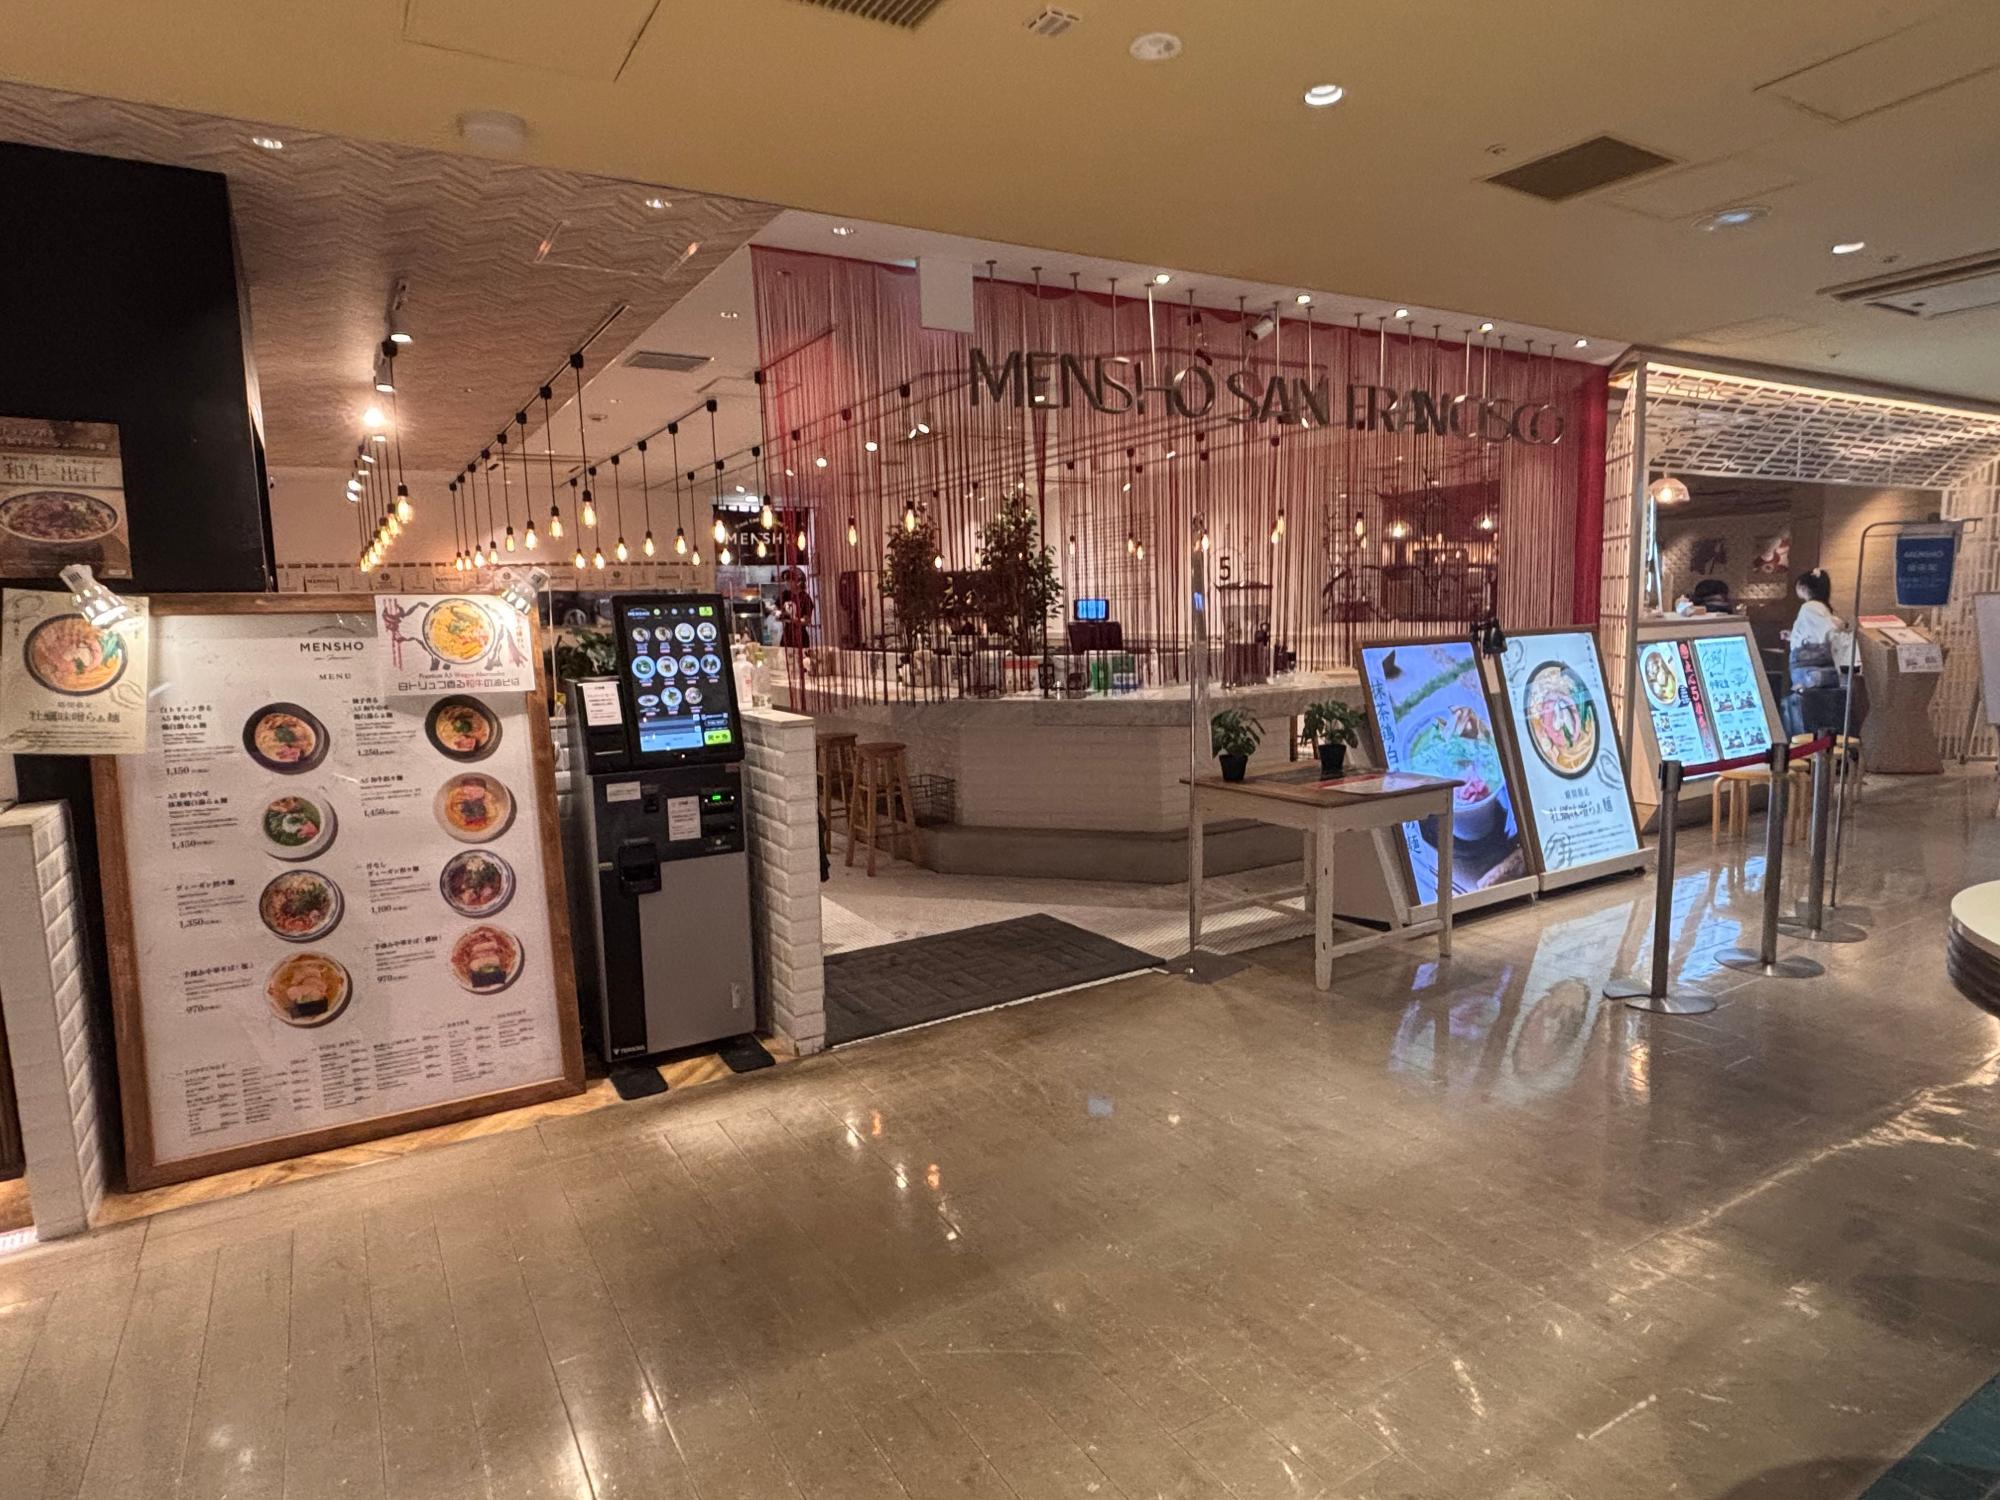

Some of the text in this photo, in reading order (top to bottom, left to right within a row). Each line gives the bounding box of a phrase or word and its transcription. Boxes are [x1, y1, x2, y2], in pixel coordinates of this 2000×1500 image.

[969, 347, 1565, 445] MENSHO SAN FRANCISCO
[1219, 556, 1231, 580] 5
[299, 641, 365, 653] MENSHO
[319, 673, 352, 681] MENU
